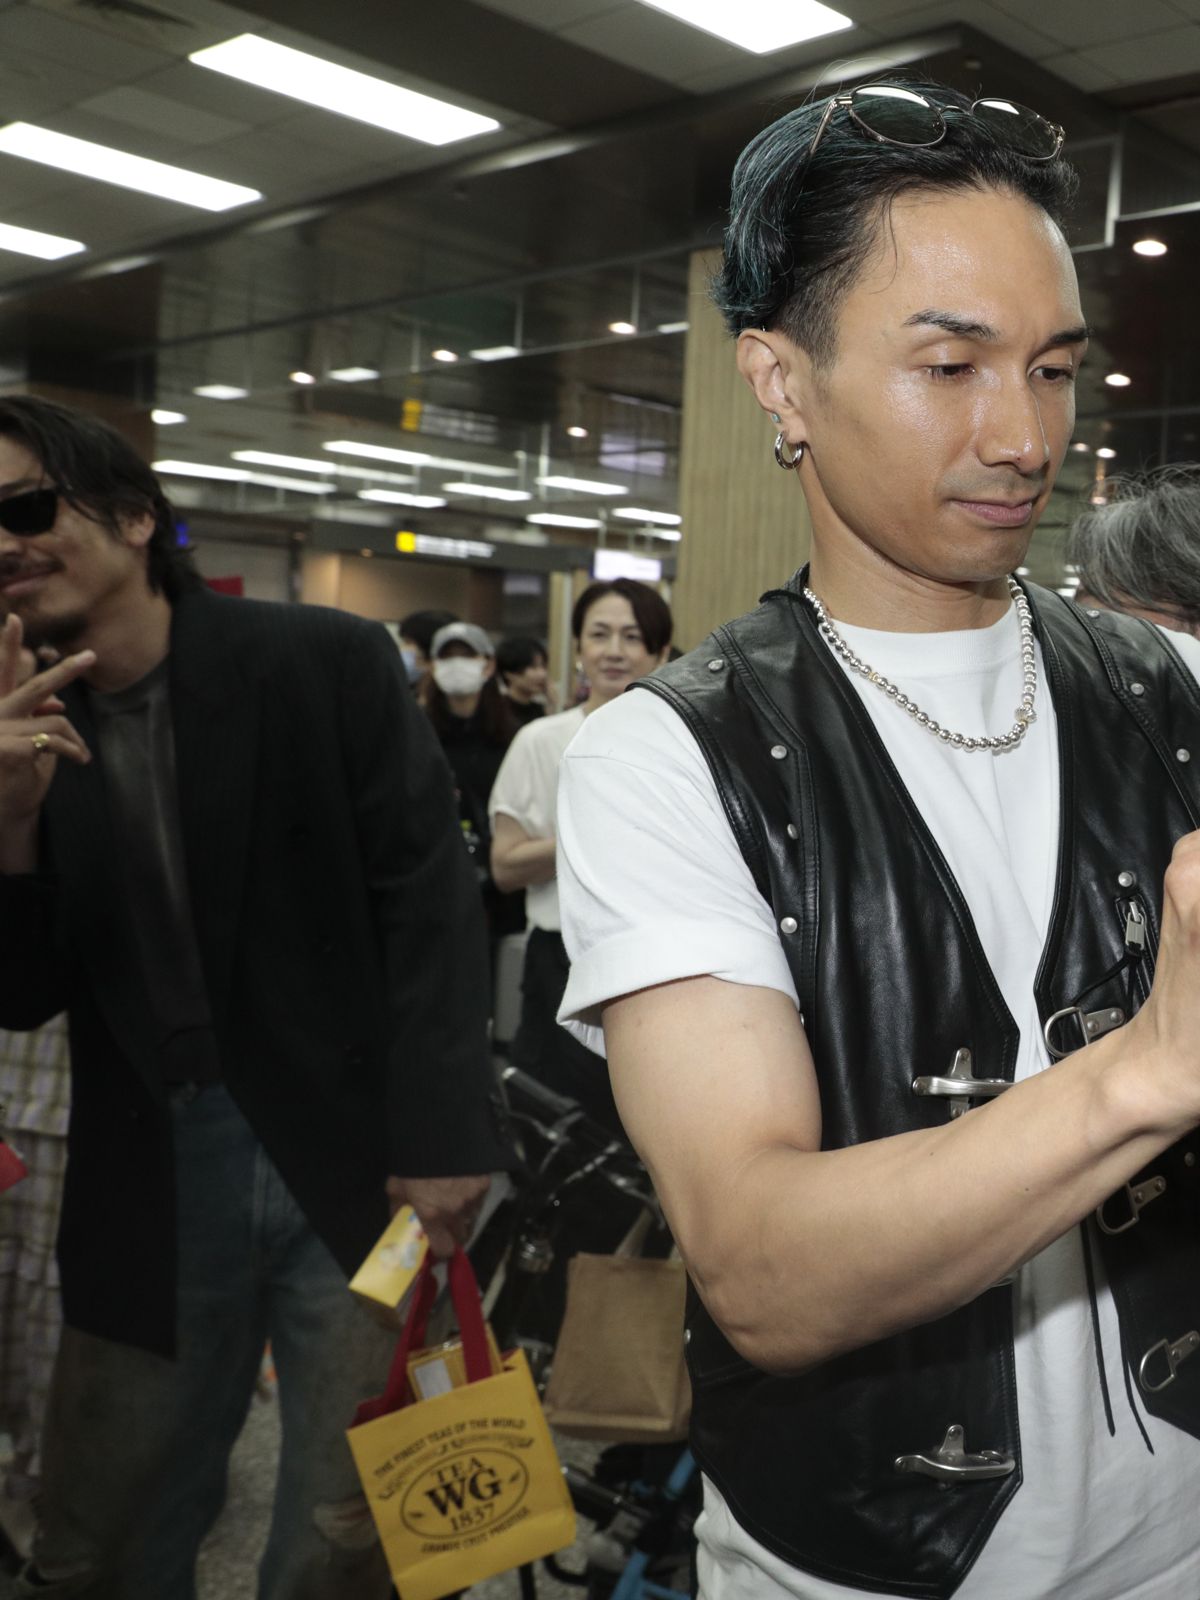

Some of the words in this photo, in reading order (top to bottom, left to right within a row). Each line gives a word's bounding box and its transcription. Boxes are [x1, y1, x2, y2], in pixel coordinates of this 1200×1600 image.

[469, 1417, 488, 1431] THE
[432, 1457, 483, 1483] TEA
[425, 1468, 501, 1516] WG
[450, 1503, 494, 1531] 1837
